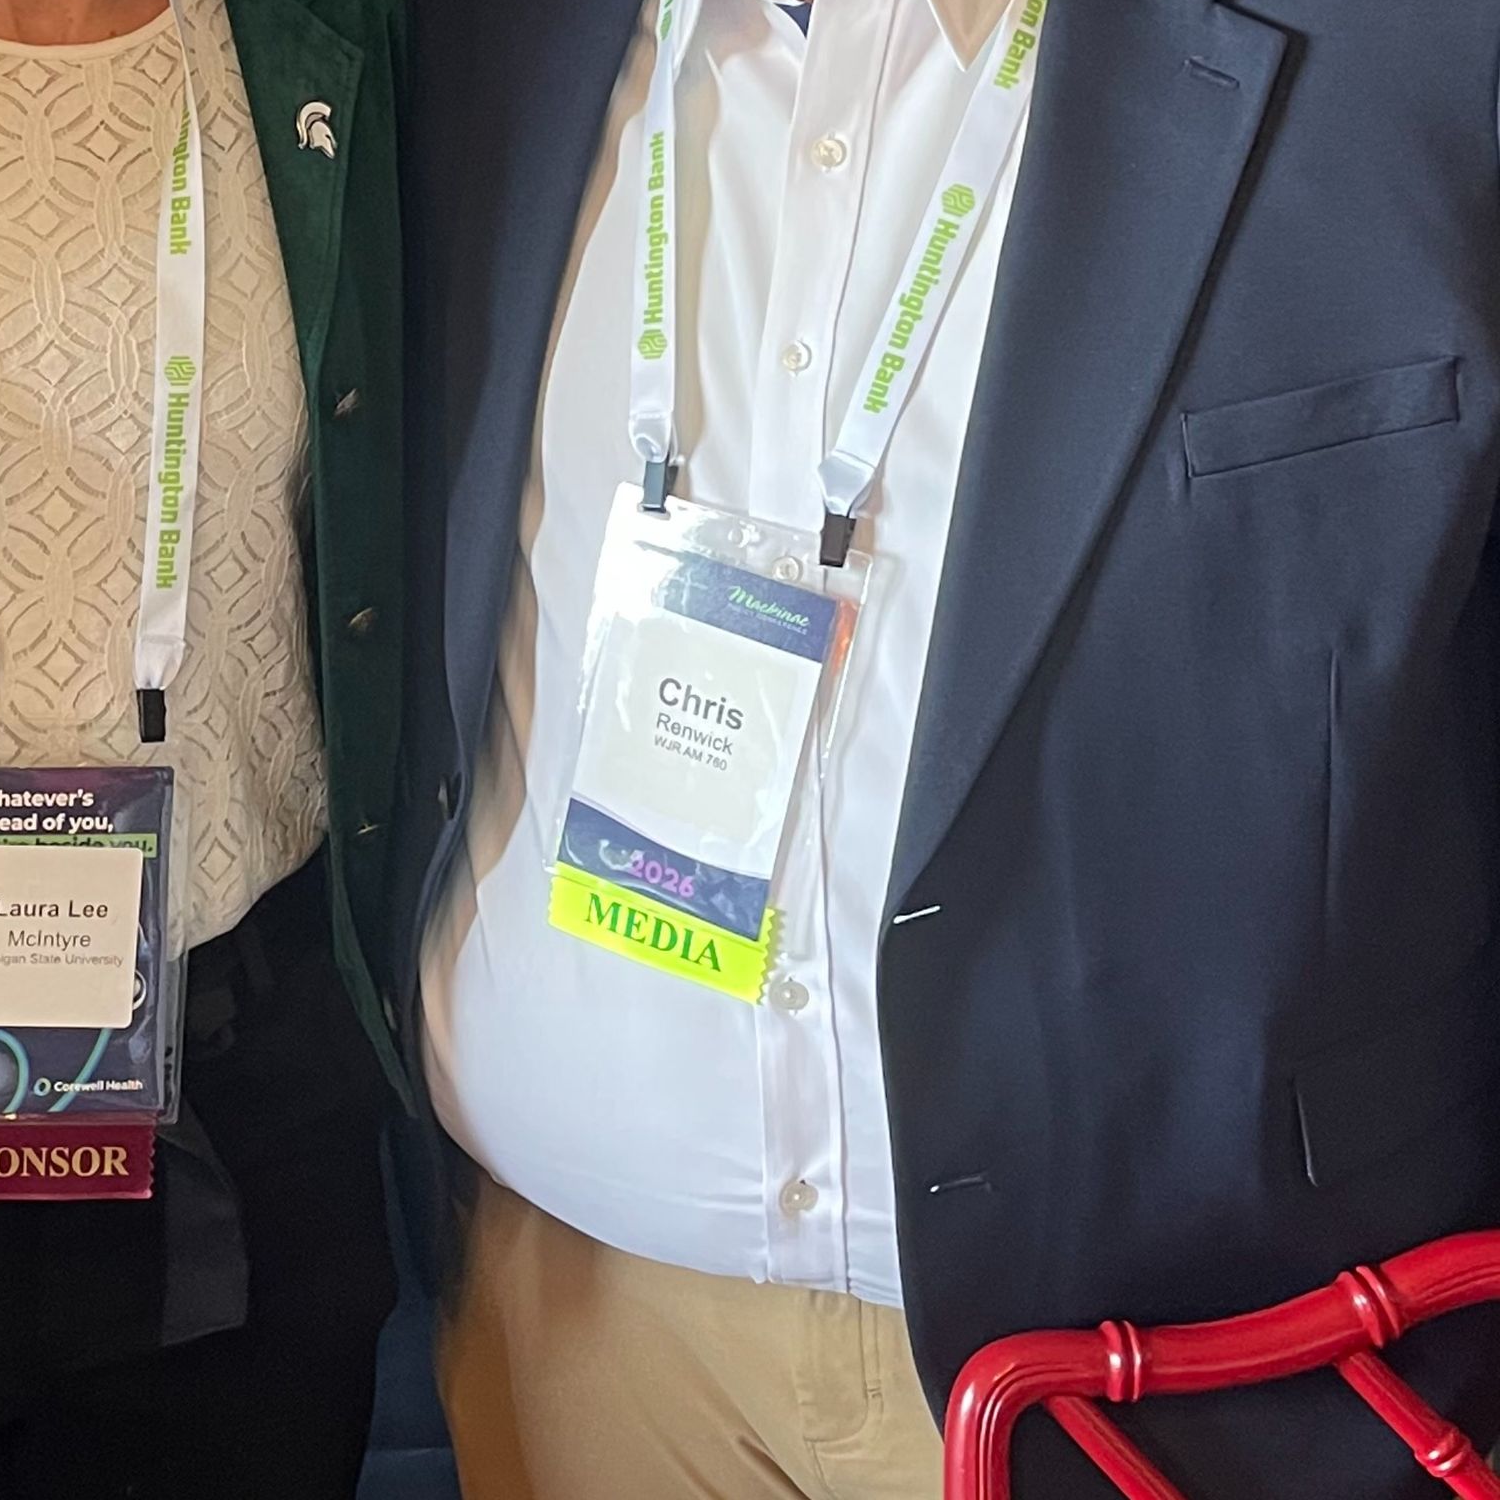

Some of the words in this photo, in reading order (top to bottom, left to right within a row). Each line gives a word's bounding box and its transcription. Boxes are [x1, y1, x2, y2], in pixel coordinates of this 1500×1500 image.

[993, 28, 1037, 90] Bank
[647, 131, 665, 191] Bank
[169, 196, 192, 255] Bank
[643, 194, 669, 325] Huntington
[888, 218, 960, 351] Huntington
[862, 352, 906, 414] Bank
[157, 392, 190, 524] Huntington
[156, 529, 181, 589] Bank
[658, 677, 745, 731] Chris
[653, 734, 682, 755] WJR
[682, 746, 703, 763] AM
[705, 753, 729, 772] 760
[655, 712, 734, 756] Renwick
[41, 813, 66, 831] of
[67, 816, 115, 835] you,
[629, 849, 695, 899] 2026
[68, 899, 109, 918] Lee
[584, 892, 722, 973] MEDIA
[7, 929, 92, 952] McIntyre
[29, 952, 62, 965] State
[64, 953, 124, 968] University
[53, 1080, 104, 1093] Corewell
[105, 1079, 144, 1091] Health
